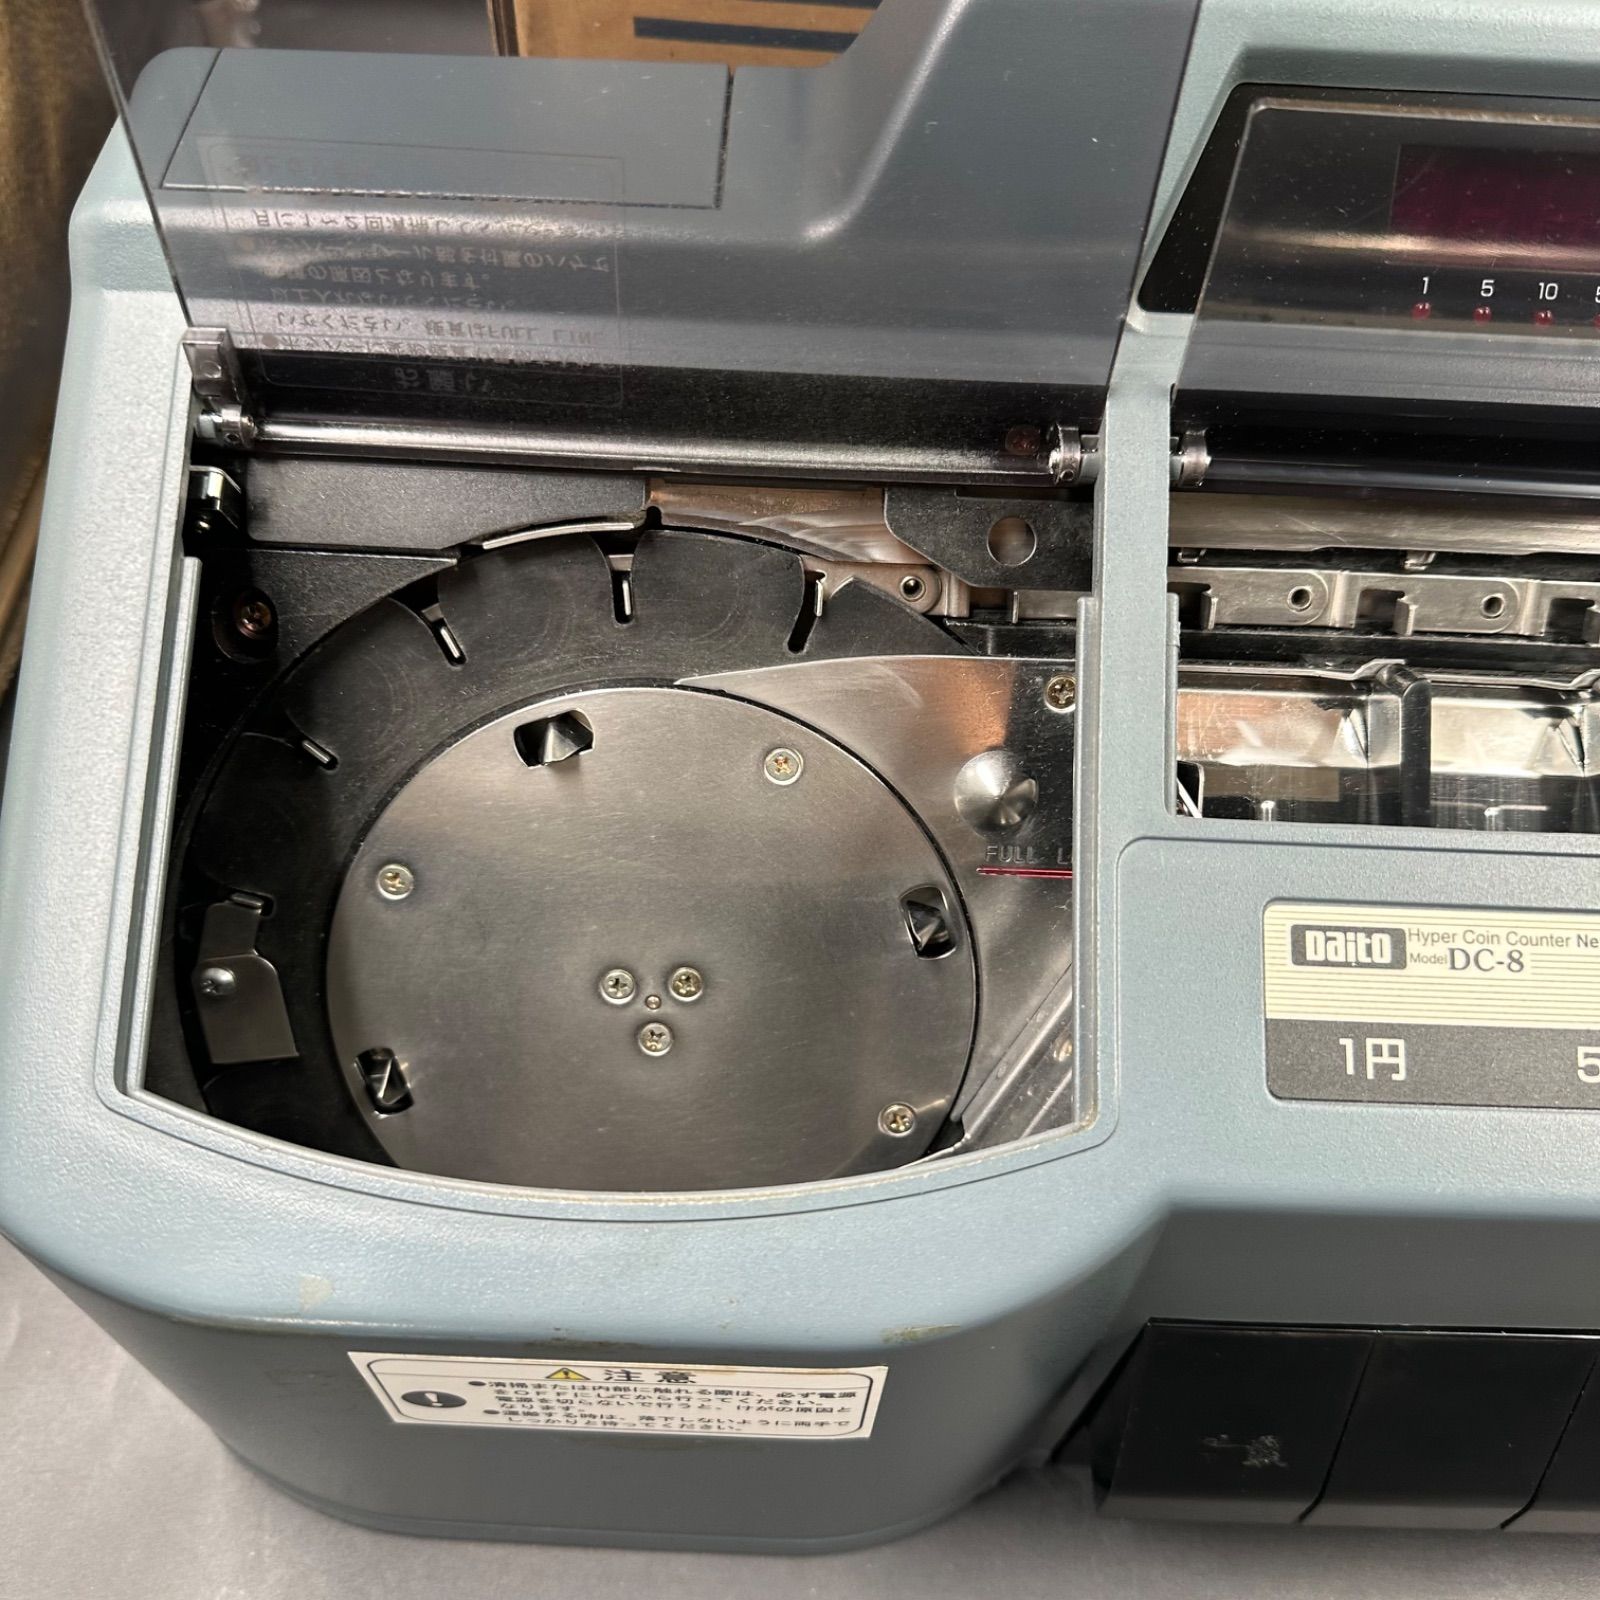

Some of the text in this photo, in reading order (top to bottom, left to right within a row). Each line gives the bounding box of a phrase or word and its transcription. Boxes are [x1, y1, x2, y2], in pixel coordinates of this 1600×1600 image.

[1422, 276, 1559, 301] 1 5 10
[985, 845, 1039, 865] FULL
[1408, 927, 1458, 946] Hyper
[1462, 929, 1501, 945] Coin
[1506, 931, 1571, 948] Counter
[1409, 948, 1525, 973] Model DC-8
[1339, 1037, 1407, 1081] 1円
[603, 1369, 697, 1384] 注意
